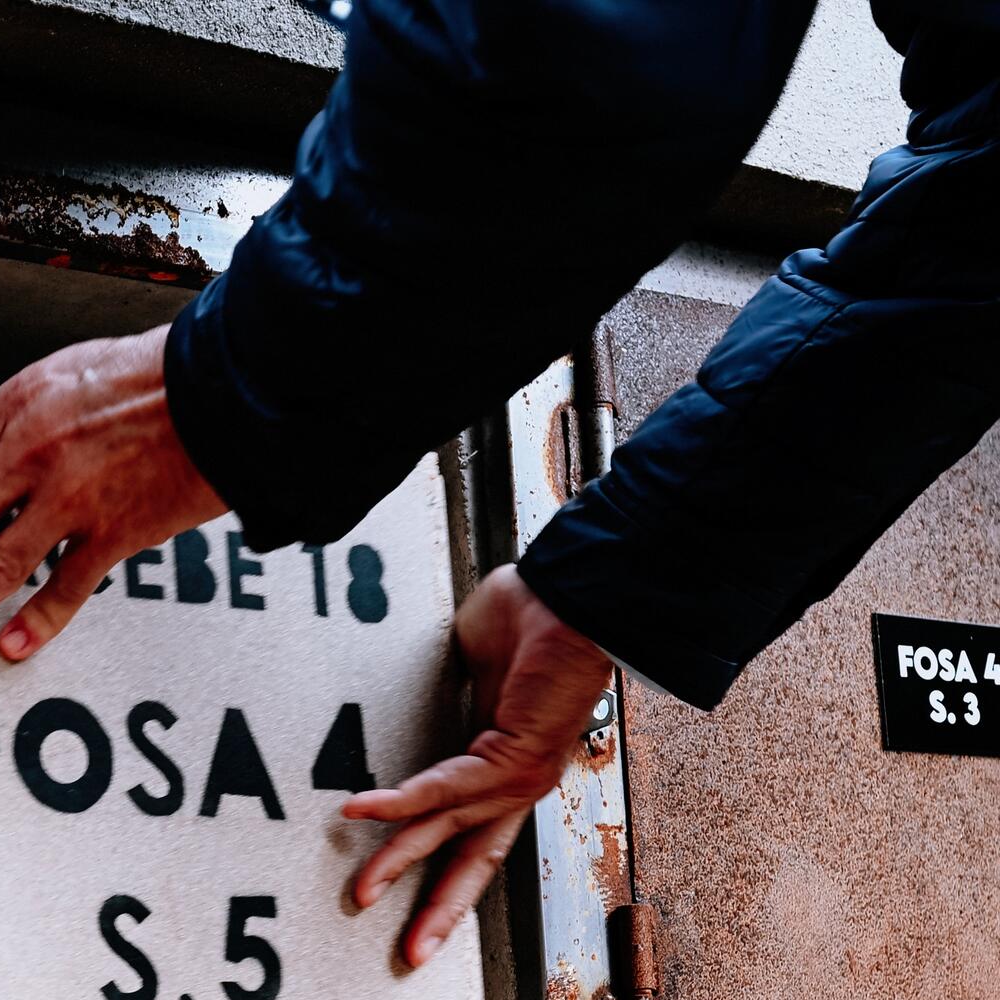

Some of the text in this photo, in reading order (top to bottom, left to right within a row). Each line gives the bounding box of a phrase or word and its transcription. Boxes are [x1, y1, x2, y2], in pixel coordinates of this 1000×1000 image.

[301, 543, 389, 623] 18
[897, 645, 1000, 685] FOSA 4
[929, 690, 981, 726] S. 3
[311, 703, 376, 793] 4
